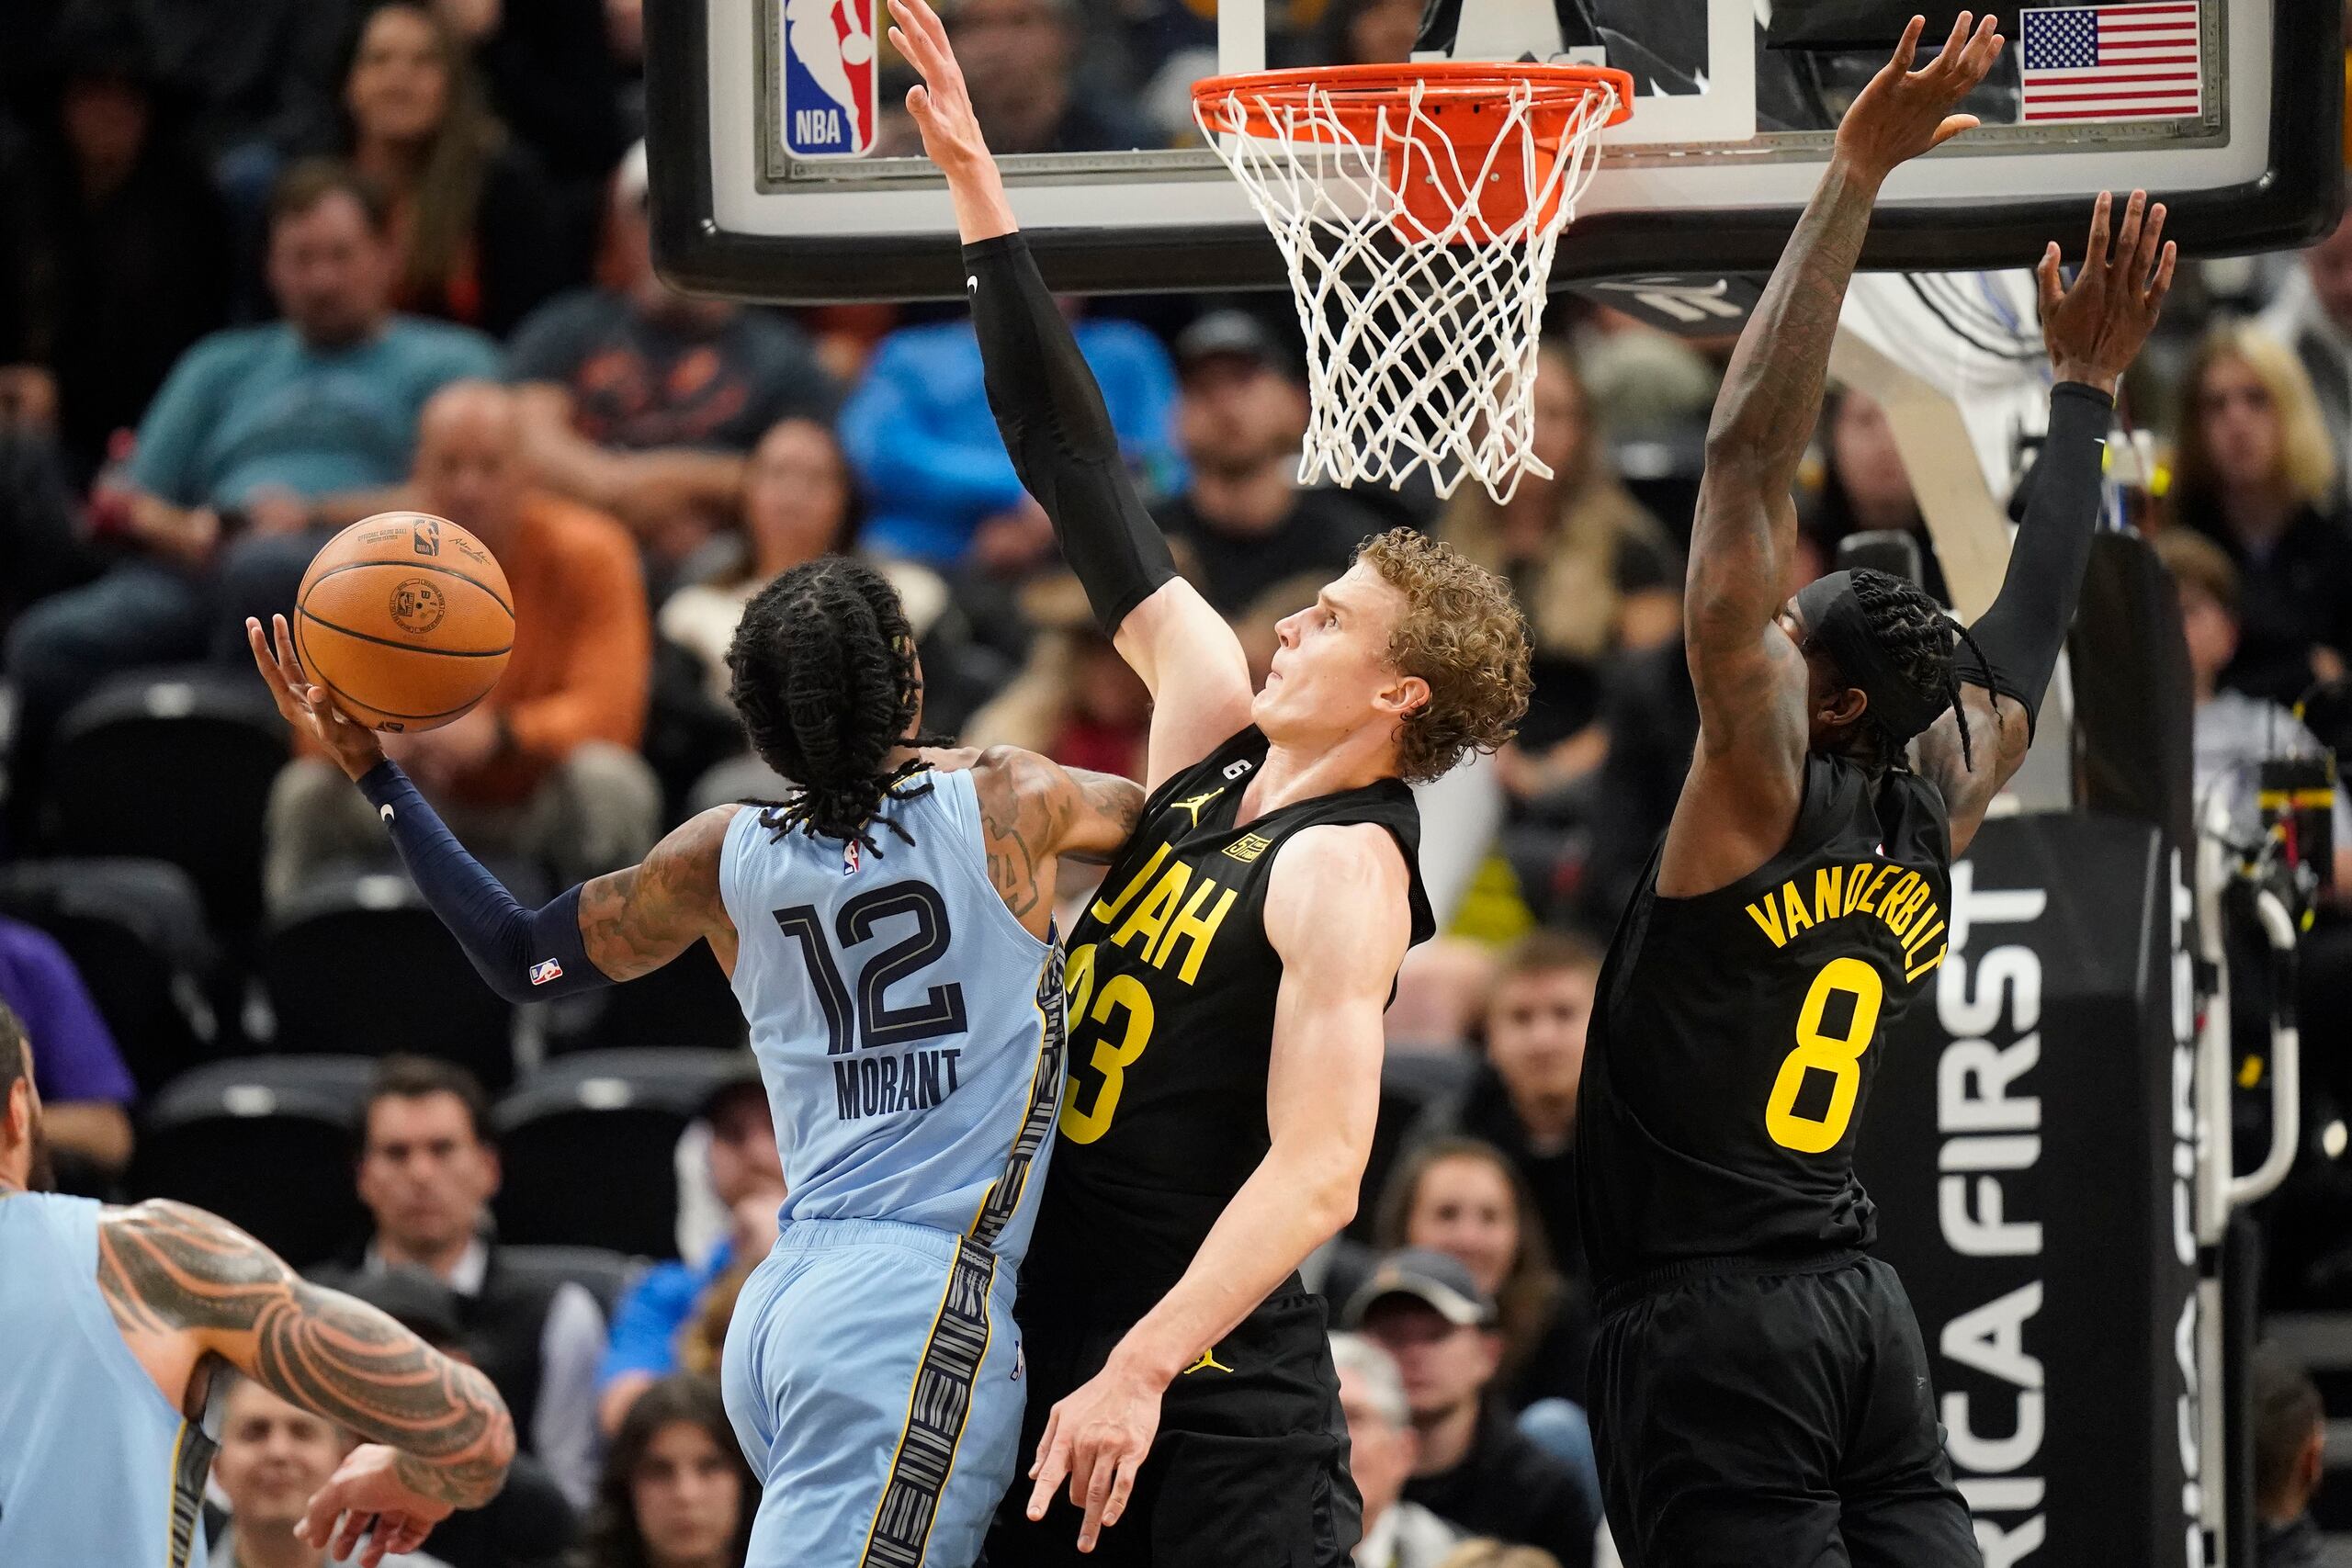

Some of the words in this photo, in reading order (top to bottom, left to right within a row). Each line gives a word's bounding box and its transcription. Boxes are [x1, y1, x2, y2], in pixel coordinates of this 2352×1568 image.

[796, 109, 842, 145] NBA
[1222, 759, 1252, 780] 6
[772, 879, 968, 1055] 12
[1745, 863, 1949, 984] VANDERBILT
[832, 1048, 962, 1121] MORANT
[1765, 956, 1883, 1155] 8
[1937, 859, 2048, 1256] FIRST
